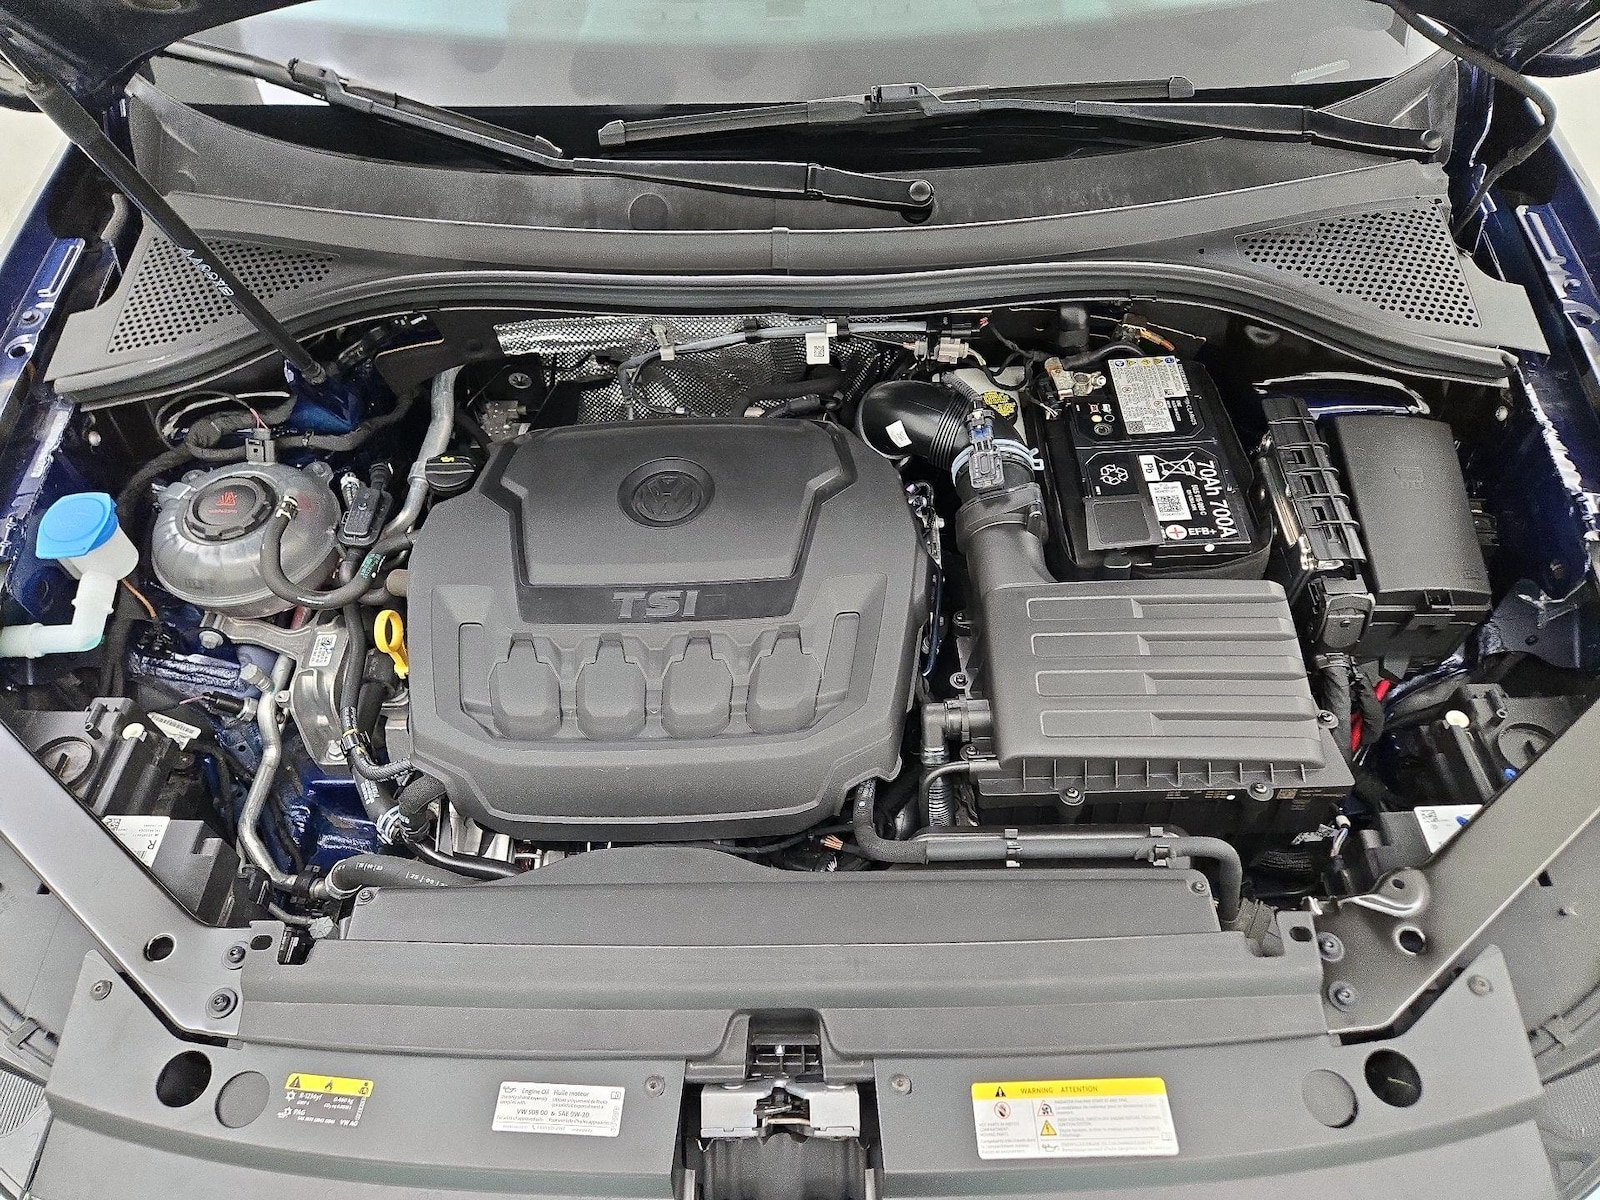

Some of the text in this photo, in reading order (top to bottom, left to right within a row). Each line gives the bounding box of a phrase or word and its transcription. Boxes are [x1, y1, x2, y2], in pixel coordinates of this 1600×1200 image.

[1143, 462, 1154, 474] Pb
[1197, 460, 1238, 538] 70Ah 700A
[1188, 526, 1217, 536] EFB+
[611, 590, 699, 619] TSI
[147, 839, 157, 850] R
[521, 1088, 541, 1097] Engine
